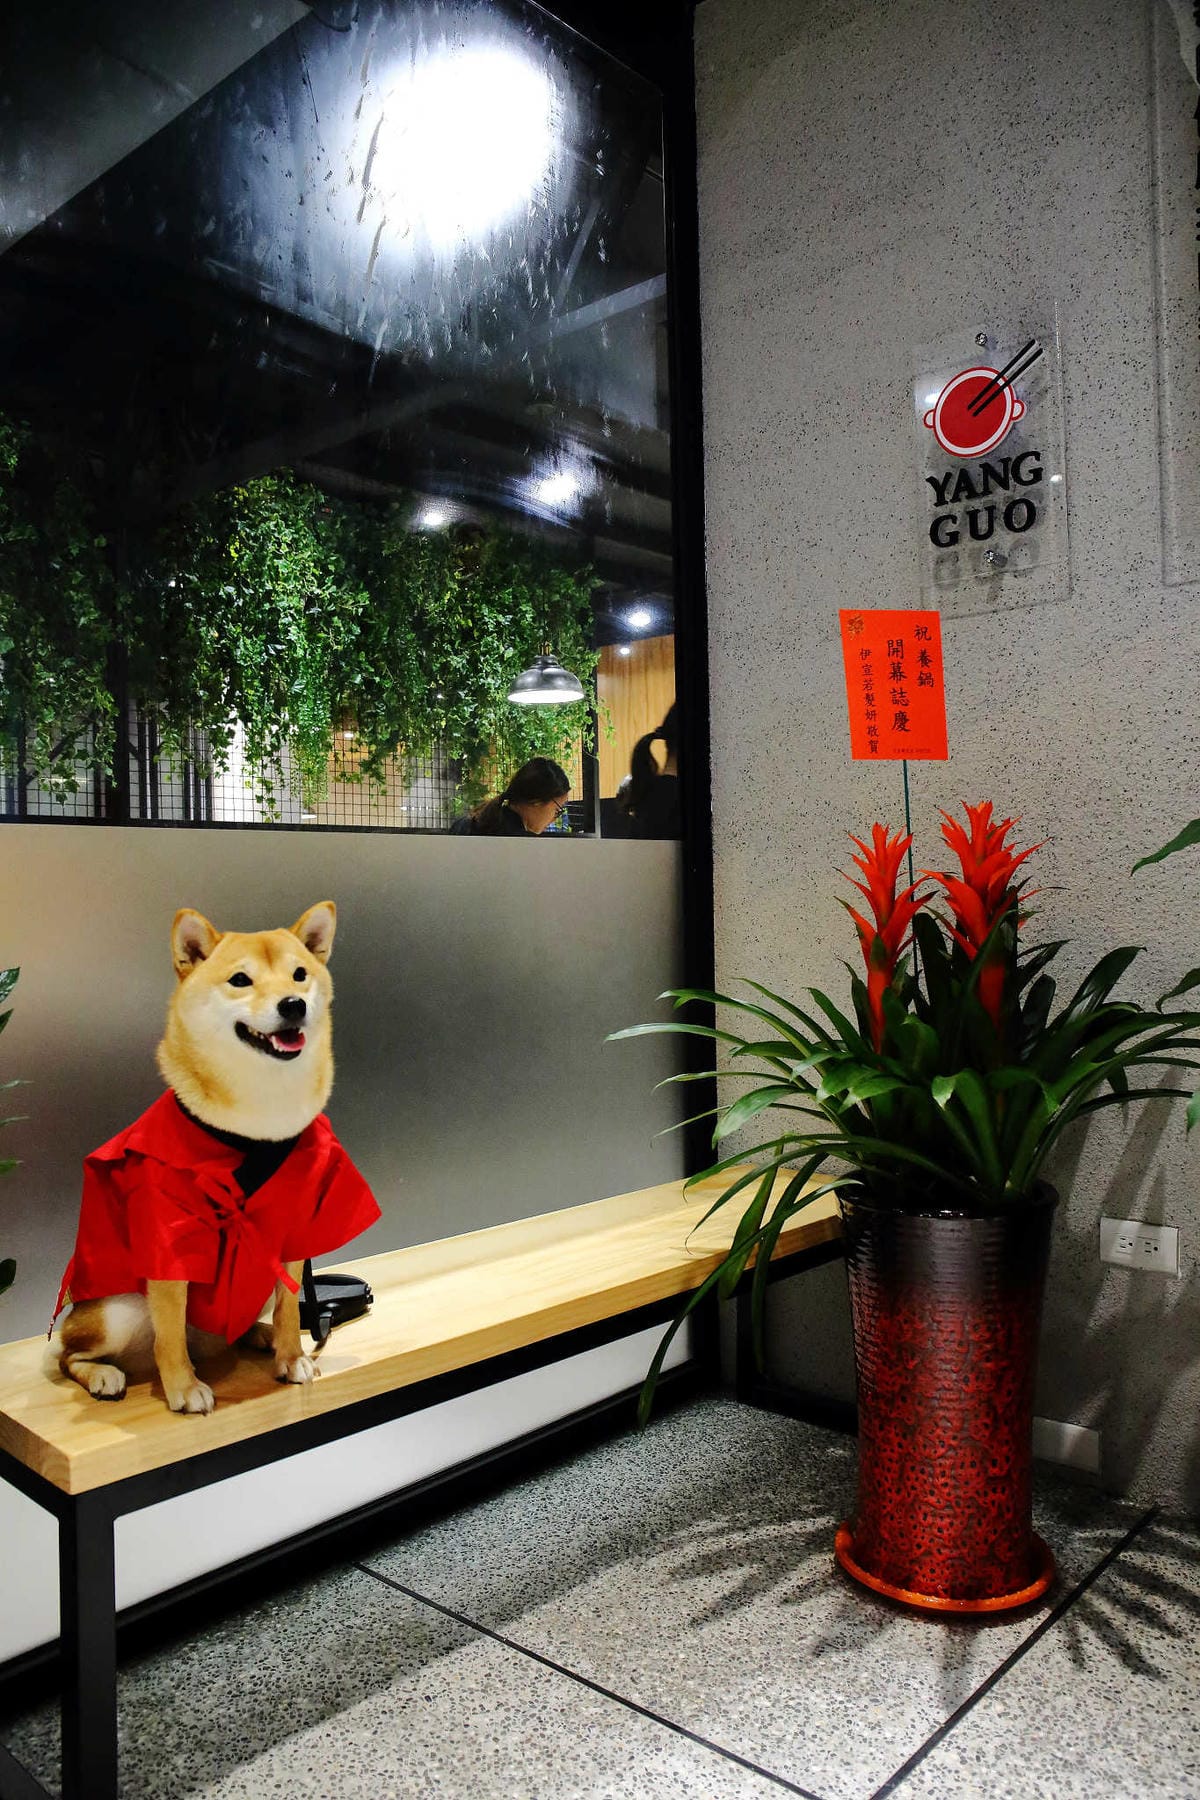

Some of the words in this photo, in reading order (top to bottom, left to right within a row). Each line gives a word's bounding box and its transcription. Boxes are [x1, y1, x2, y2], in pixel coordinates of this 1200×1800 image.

[925, 450, 1044, 508] YANG
[929, 498, 1037, 548] GUO
[886, 638, 912, 733] 開幕誌慶
